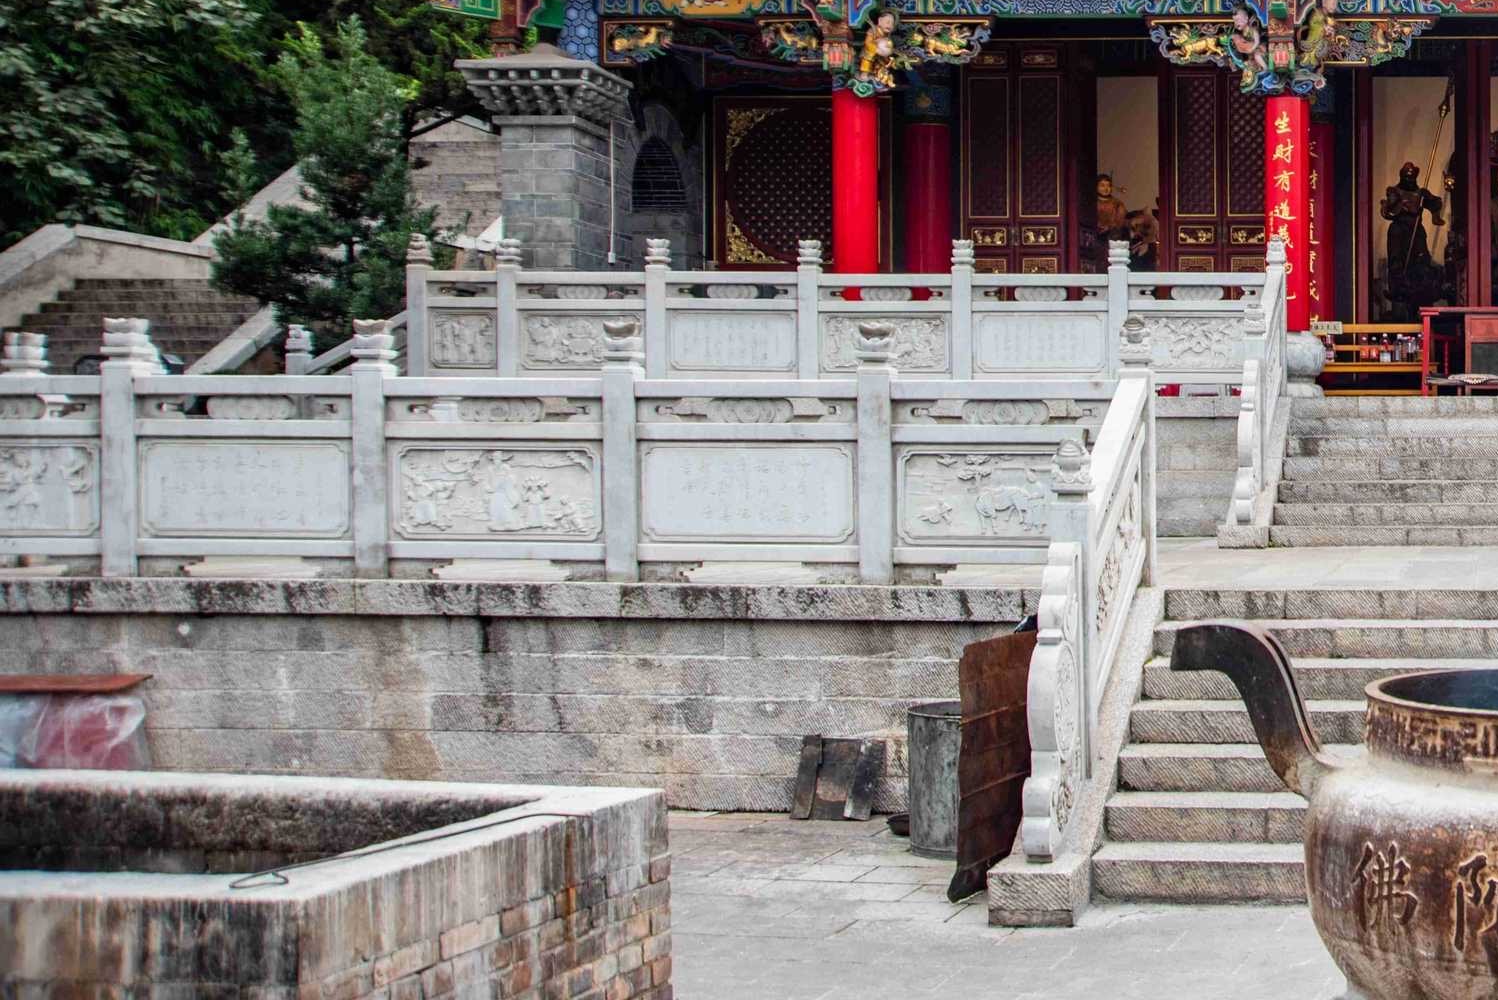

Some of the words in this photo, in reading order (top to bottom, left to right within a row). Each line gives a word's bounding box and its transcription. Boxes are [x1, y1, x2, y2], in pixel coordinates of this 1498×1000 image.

[1272, 110, 1297, 300] 生財有道義
